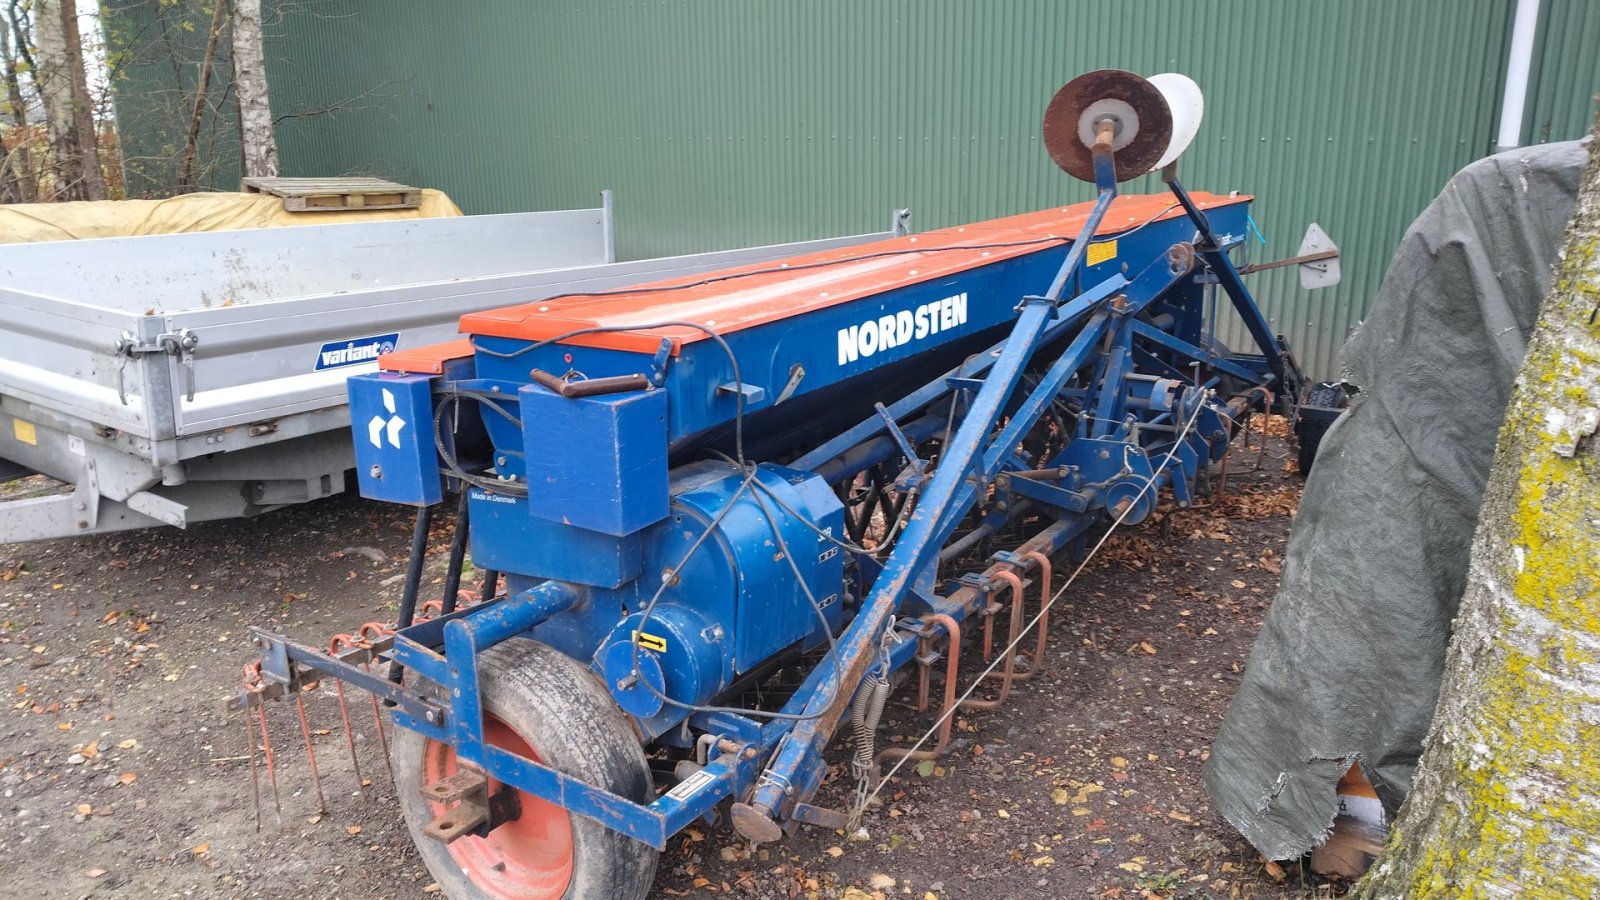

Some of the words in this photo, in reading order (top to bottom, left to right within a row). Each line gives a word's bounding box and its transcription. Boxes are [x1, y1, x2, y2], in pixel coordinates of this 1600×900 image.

[838, 292, 968, 366] NORDSTEN
[321, 342, 381, 366] variant
[471, 492, 486, 501] Made
[493, 494, 517, 504] Denmark
